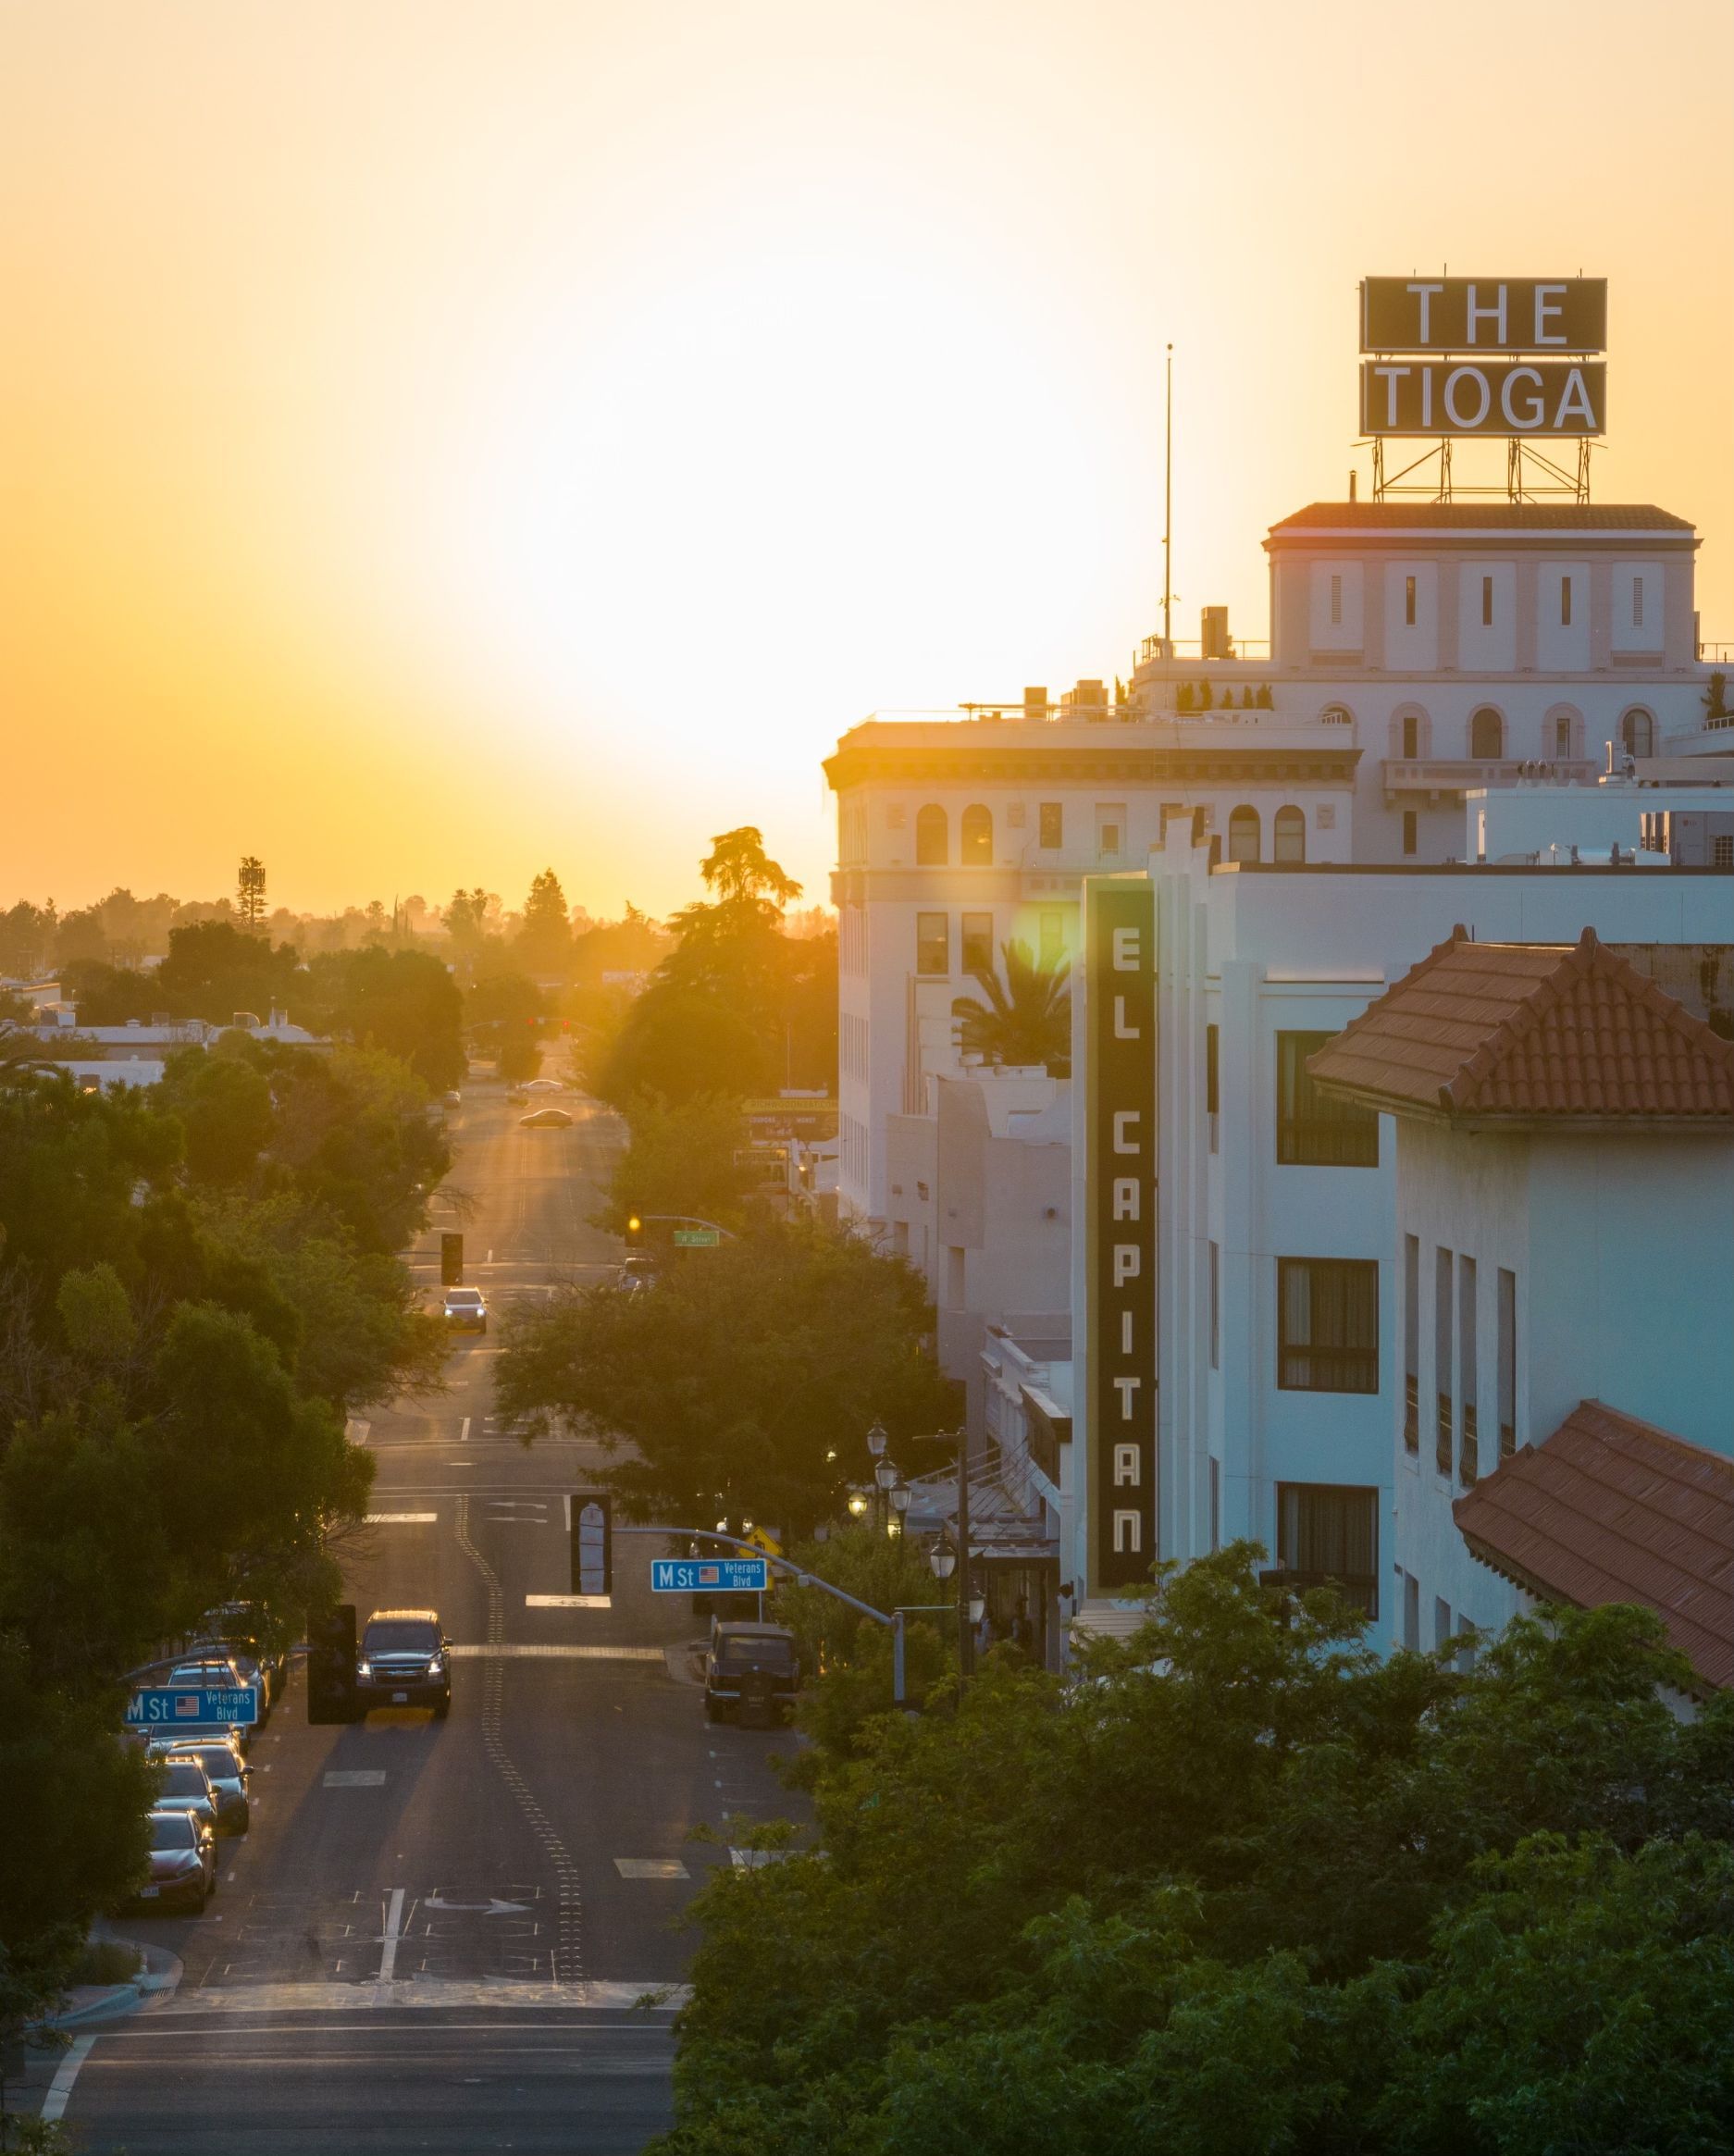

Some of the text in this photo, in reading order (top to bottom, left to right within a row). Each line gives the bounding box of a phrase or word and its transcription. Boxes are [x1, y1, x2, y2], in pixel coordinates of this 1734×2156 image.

[1406, 284, 1567, 343] THE
[1375, 366, 1596, 427] TIOGA
[1113, 927, 1140, 1552] EL CAPITAN
[660, 1565, 694, 1587] M St
[725, 1563, 761, 1574] Veterans
[733, 1575, 750, 1587] Blvd
[128, 1693, 168, 1720] M St
[206, 1691, 250, 1704] Veterans
[217, 1706, 238, 1720] Blvd
